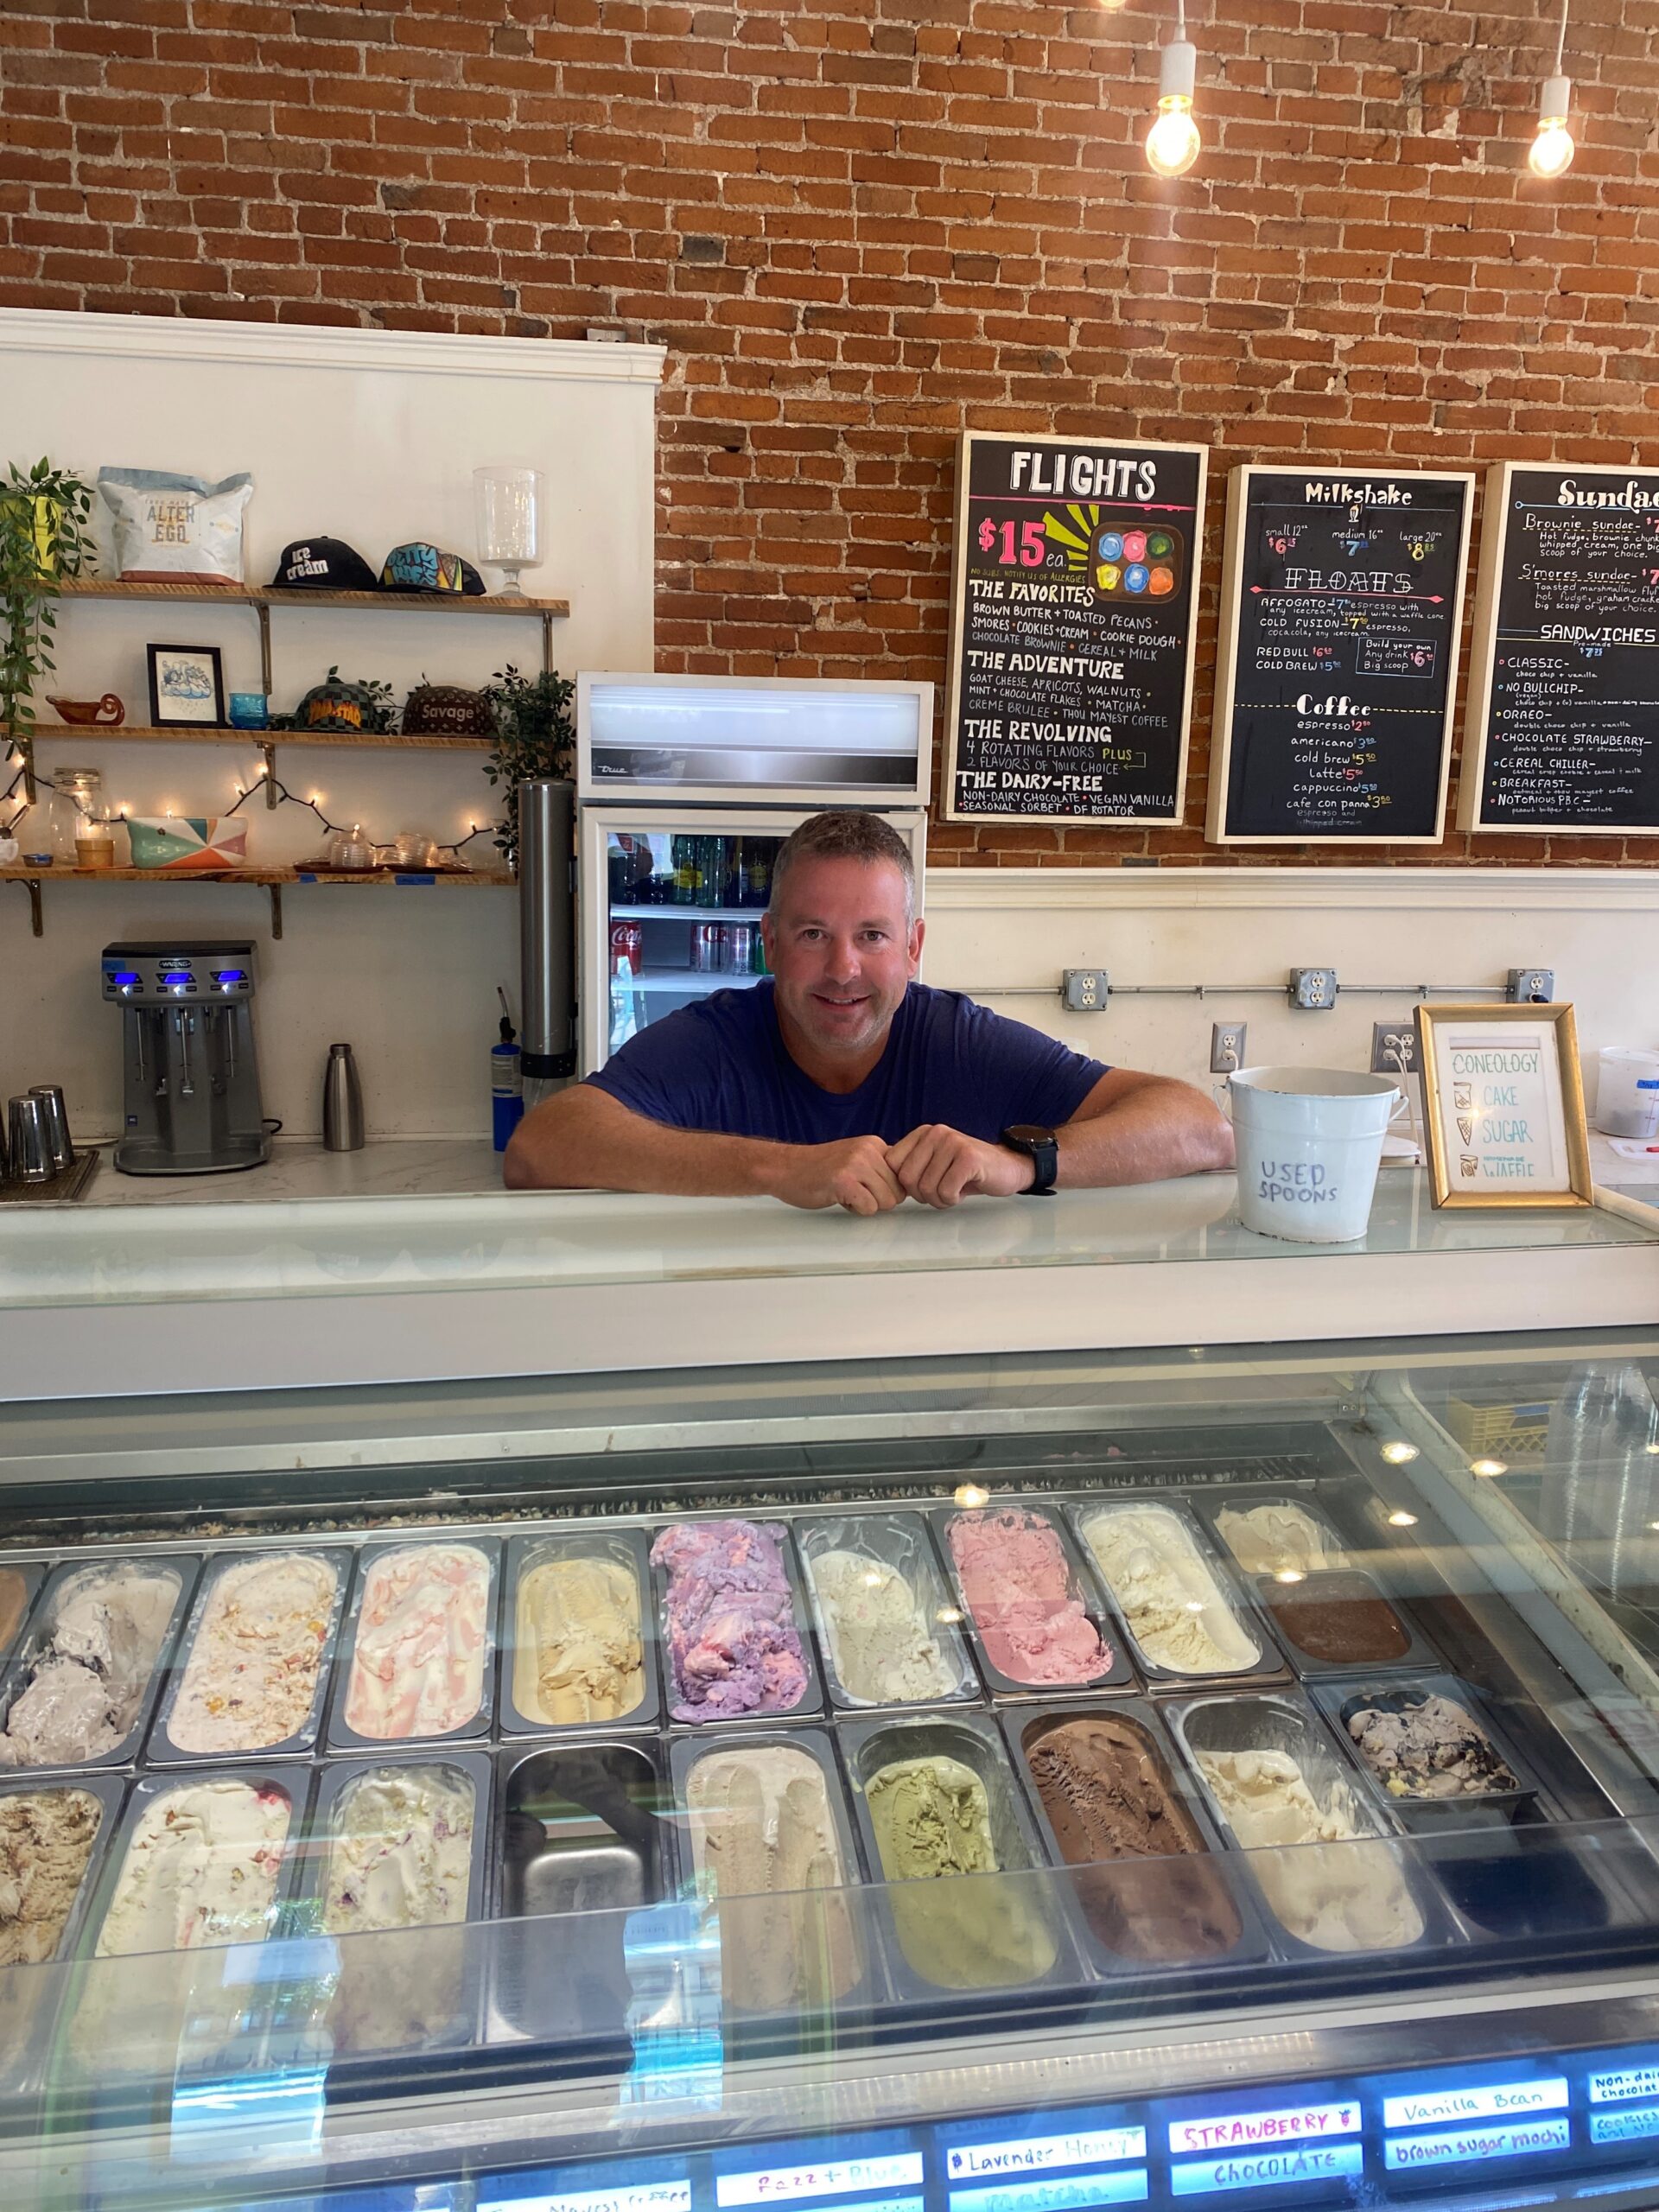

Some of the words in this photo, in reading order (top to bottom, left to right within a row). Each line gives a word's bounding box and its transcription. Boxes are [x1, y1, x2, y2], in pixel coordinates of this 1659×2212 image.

[1010, 451, 1157, 501] FLIGHTS
[1305, 482, 1414, 505] Milkshake
[147, 505, 195, 523] ALTER
[1525, 512, 1582, 529] Brownie
[156, 524, 186, 543] EGO
[1265, 524, 1290, 537] small
[1332, 528, 1365, 539] medium
[1400, 531, 1424, 543] large
[1540, 531, 1557, 540] Hot
[1592, 532, 1630, 542] brownie
[978, 518, 1046, 567] $15
[1539, 540, 1577, 550] whipped
[1571, 547, 1582, 556] of
[1588, 550, 1607, 559] your
[1051, 572, 1086, 584] ALLERGIES
[1522, 563, 1578, 578] S'mores
[1284, 567, 1414, 594] FLOATS
[1535, 582, 1577, 591] Toasted
[1580, 584, 1637, 594] marshmallow
[969, 579, 1004, 599] THE
[1009, 582, 1095, 607] FAVORITES
[1535, 591, 1553, 601] hot
[1596, 593, 1630, 603] graham
[1351, 601, 1396, 612] espresso
[1400, 603, 1419, 612] with
[1535, 601, 1549, 610] big
[1556, 601, 1580, 612] scoop
[1599, 606, 1618, 615] your
[973, 602, 1010, 616] BROWN
[1013, 606, 1052, 620] BUTTER
[1063, 609, 1106, 625] TOASTED
[1110, 614, 1152, 630] PECANS
[1260, 618, 1287, 627] COLD
[971, 616, 1010, 632] SMORES
[1016, 620, 1054, 635] COOKIES
[1100, 630, 1135, 644] COOKIE
[1138, 634, 1176, 649] DOUGH
[1541, 624, 1656, 643] SANDWICHES
[972, 631, 1020, 645] CHOCOLATE
[1024, 635, 1067, 652] BROWNIE
[1078, 643, 1117, 658] CEREAL
[1128, 648, 1159, 662] MILK
[1256, 646, 1281, 657] RED
[1283, 648, 1309, 657] BULL
[1365, 639, 1389, 649] Build
[1393, 642, 1413, 651] your
[1364, 650, 1382, 662] Any
[1385, 650, 1409, 659] drink
[967, 650, 1006, 671] THE
[1008, 653, 1125, 680] ADVENTURE
[1255, 661, 1283, 670] COLD
[1285, 661, 1318, 671] BREW
[1363, 661, 1381, 671] Big
[1384, 662, 1409, 673] scoop
[969, 673, 993, 683] GOAT
[1087, 685, 1141, 699] WALNUTS
[1506, 683, 1520, 692] NO
[969, 686, 990, 695] MINT
[999, 689, 1046, 702] CHOCOLATE
[1050, 693, 1081, 708] FLAKES
[1096, 699, 1141, 712] MATCHA
[1296, 693, 1371, 716] Coffee
[422, 704, 475, 722] Savage
[969, 699, 1004, 711] CREME
[1007, 702, 1051, 719] BRULEE
[1063, 709, 1086, 721] THOU
[1090, 711, 1128, 724] MAYEST
[1131, 715, 1168, 728] COFFEE
[964, 719, 1002, 739] THE
[1009, 721, 1112, 743] REVOLVING
[1297, 721, 1351, 731] espresso
[1291, 738, 1354, 748] americano
[1502, 733, 1567, 743] CHOCOLATE
[966, 740, 976, 754] 4
[982, 741, 1043, 757] ROTATING
[1046, 744, 1095, 759] FLAVORS
[1103, 747, 1132, 761] PLUS
[1294, 750, 1319, 763] cold
[1324, 752, 1351, 764] brew
[967, 757, 976, 767] 2
[980, 756, 1030, 771] FLAVORS
[1035, 760, 1048, 772] OF
[1052, 760, 1078, 773] YOUR
[1081, 761, 1119, 775] CHOICE
[1500, 758, 1543, 768] CEREAL
[957, 770, 997, 789] THE
[1001, 771, 1103, 791] DAIRY-FREE
[1293, 783, 1359, 794] cappuccino
[963, 790, 1020, 802] NON-DAIRY
[1023, 792, 1080, 804] CHOCOLATE
[1089, 793, 1127, 804] VEGAN
[1129, 794, 1174, 807] VANILLA
[1286, 797, 1311, 808] cafe
[1318, 799, 1337, 808] con
[1341, 800, 1370, 811] panna
[1498, 793, 1555, 806] NOTORIOUS
[963, 801, 1016, 812] SEASONAL
[1020, 802, 1062, 813] SORBET
[1073, 804, 1088, 815] DF
[1091, 805, 1135, 816] ROTATOR
[1452, 1052, 1538, 1074] CONEOLOGY
[1484, 1086, 1519, 1107] CAKE
[1483, 1119, 1533, 1144] SUGAR
[1262, 1160, 1325, 1185] USED
[1258, 1180, 1338, 1203] SPOONS
[1404, 2098, 1478, 2120] Vanilla
[1494, 2093, 1543, 2108] Bean
[1184, 2113, 1329, 2149] STRAWBERRY
[1396, 2145, 1452, 2164] brown
[1457, 2134, 1506, 2156] sugar
[1512, 2125, 1567, 2150] mochi
[969, 2148, 1054, 2171] Lavender
